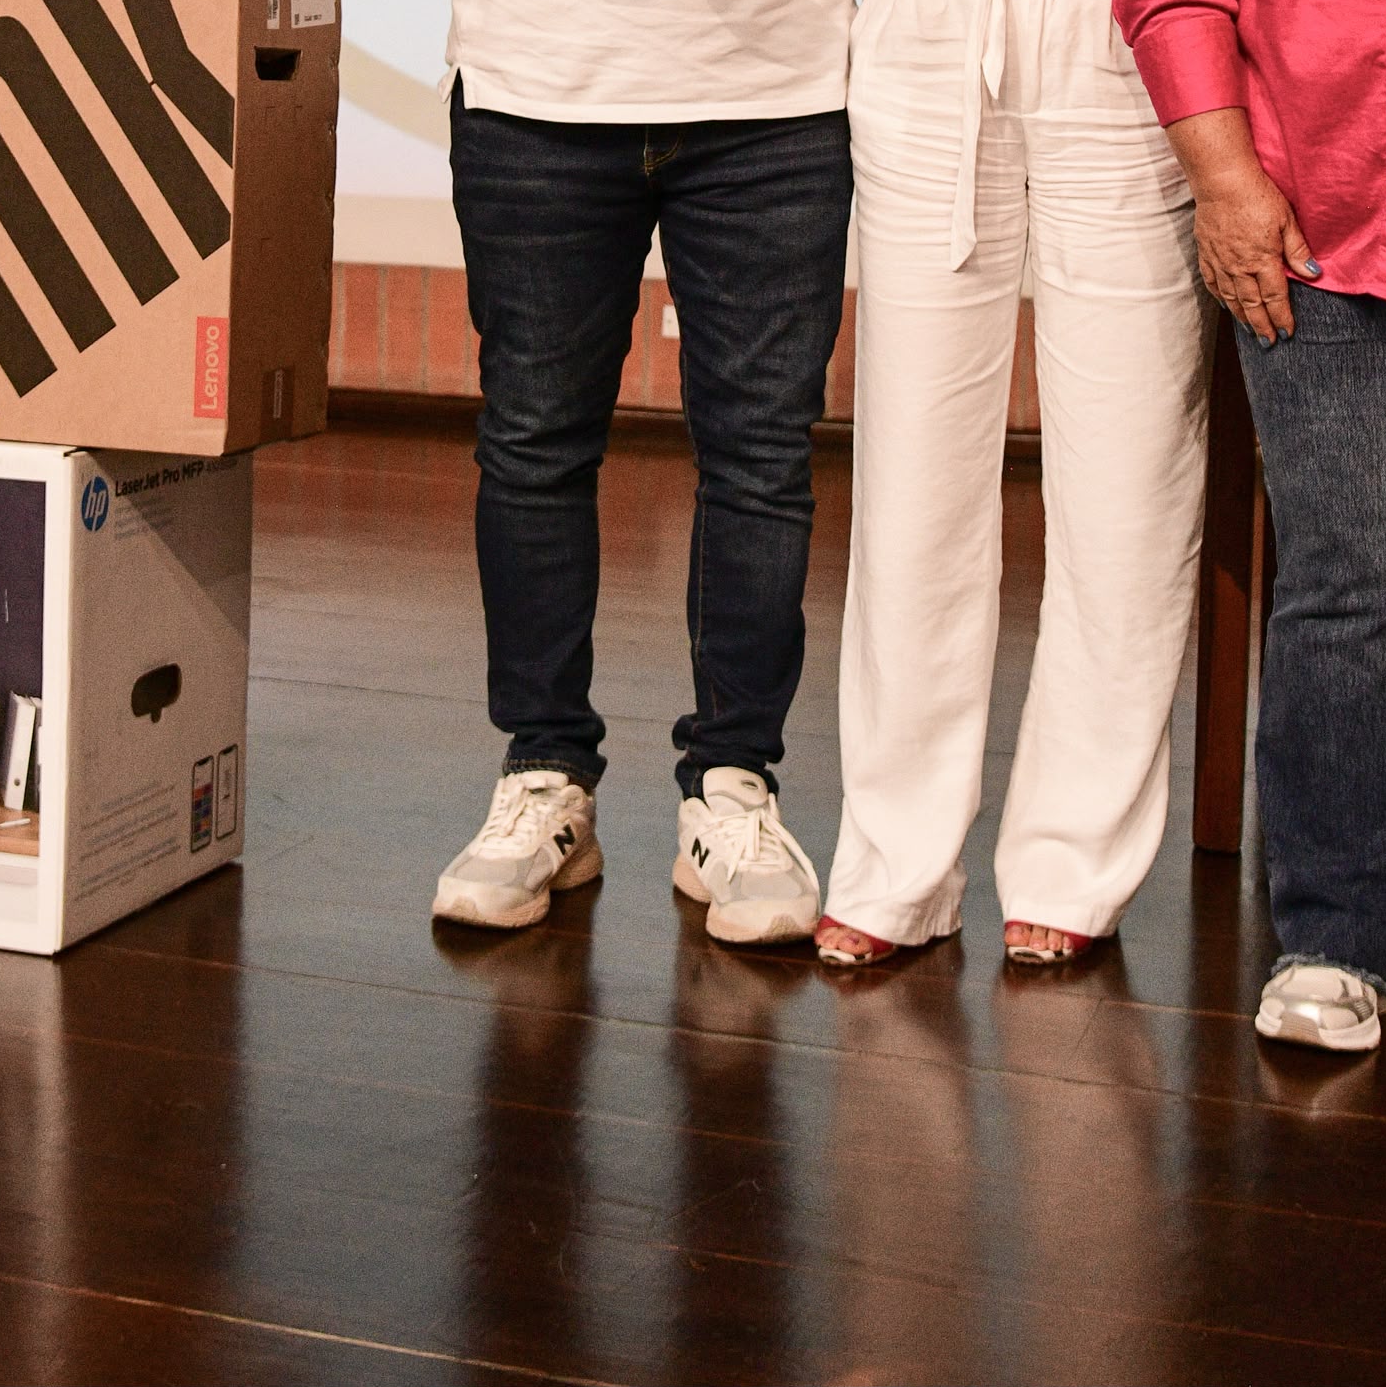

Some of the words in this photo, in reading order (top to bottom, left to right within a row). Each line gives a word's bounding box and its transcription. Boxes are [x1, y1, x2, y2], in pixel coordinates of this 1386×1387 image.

[200, 325, 220, 410] Lenovo
[81, 476, 109, 532] hp
[115, 471, 160, 497] LaserJet
[164, 467, 180, 485] Pro
[183, 460, 204, 480] MFP
